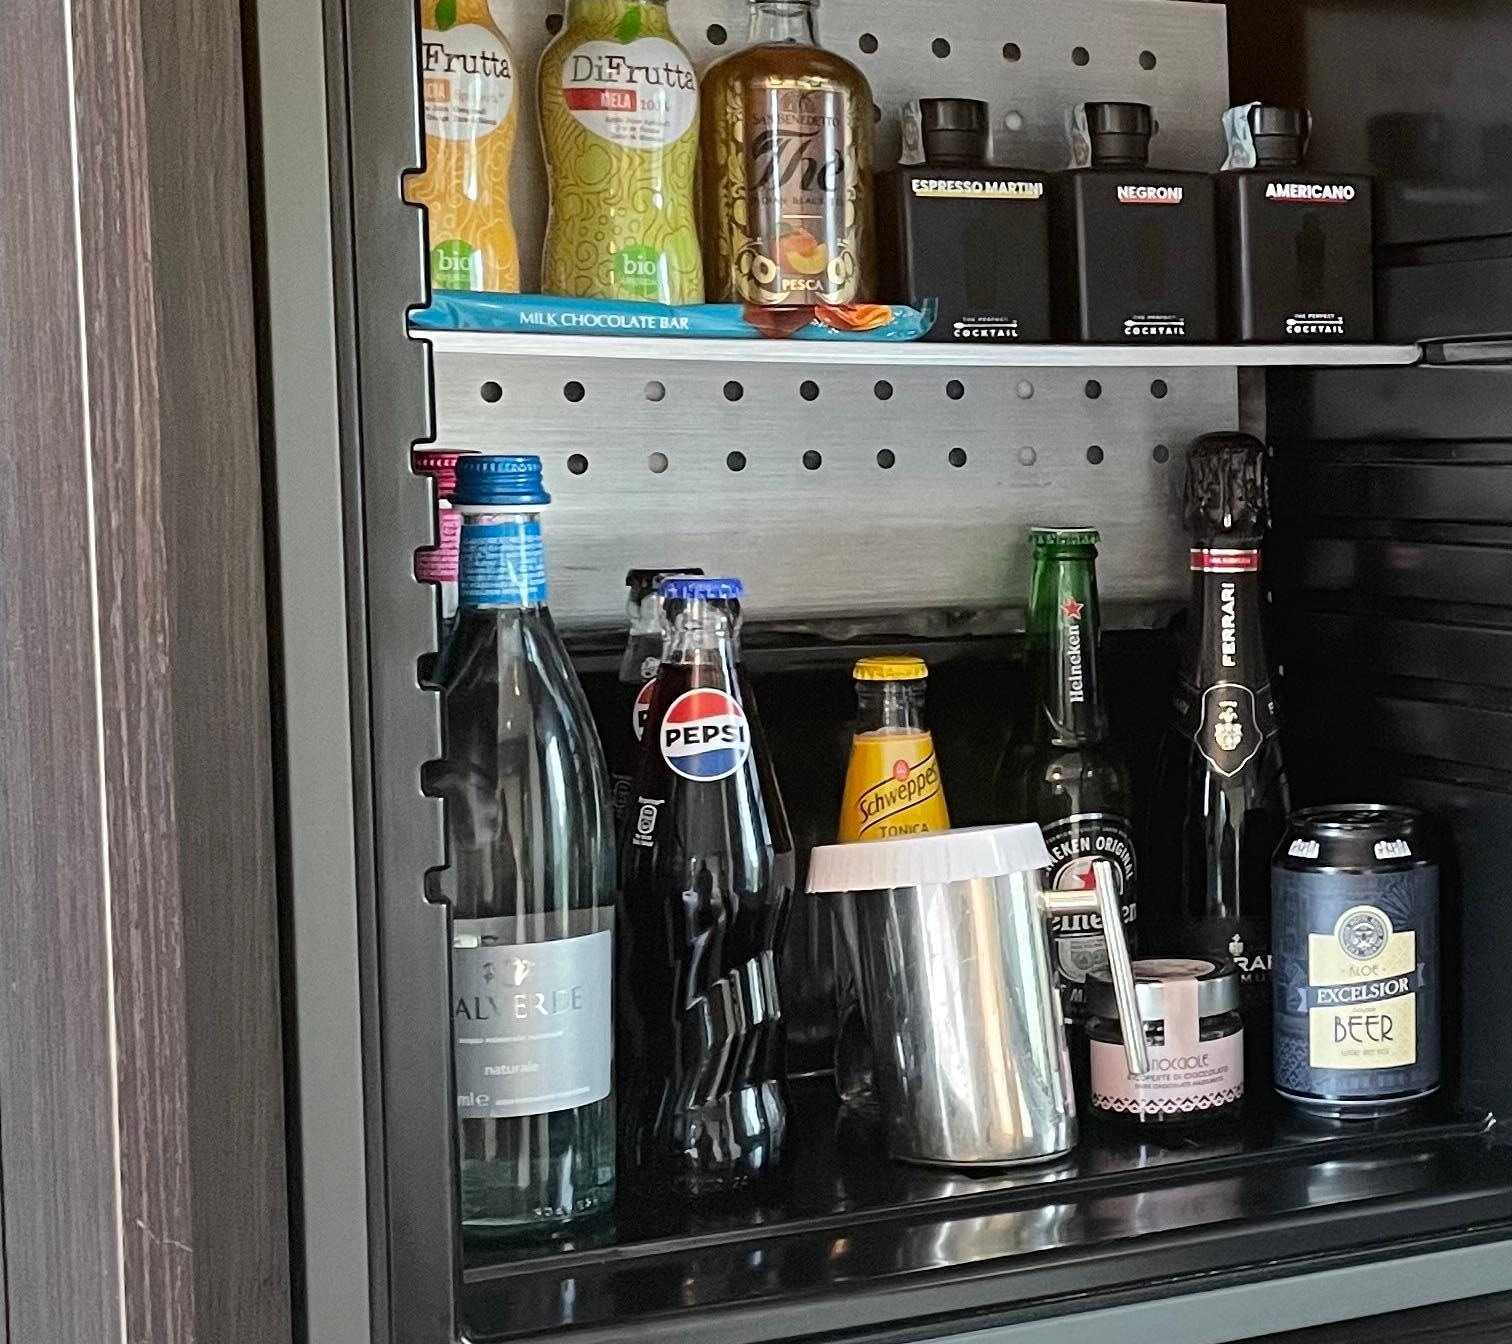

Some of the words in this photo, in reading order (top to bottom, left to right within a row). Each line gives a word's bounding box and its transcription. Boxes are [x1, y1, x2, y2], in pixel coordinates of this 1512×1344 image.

[571, 55, 696, 91] DiFrutta
[912, 179, 983, 194] ESPRESSO
[985, 182, 1043, 196] MARTINI
[1117, 185, 1183, 202] NEGRONI
[1265, 184, 1355, 201] AMERICANO
[623, 253, 656, 276] bio
[782, 279, 824, 291] PESCA
[519, 311, 557, 325] MILK
[560, 312, 656, 329] CHOCOLATE
[659, 316, 689, 330] BAR
[1286, 325, 1344, 334] COCKTAIL
[953, 329, 1018, 337] COCKTAIL
[1124, 327, 1185, 335] COCKTAIL
[1221, 582, 1236, 667] FERRARI
[1069, 624, 1084, 703] Heineken
[666, 724, 745, 748] PEPSI
[879, 822, 929, 839] TONICA
[1096, 836, 1135, 881] ORIGINAL
[1317, 977, 1409, 1004] EXCELSIOR
[1334, 1014, 1394, 1043] BEER
[484, 1061, 541, 1076] naturale
